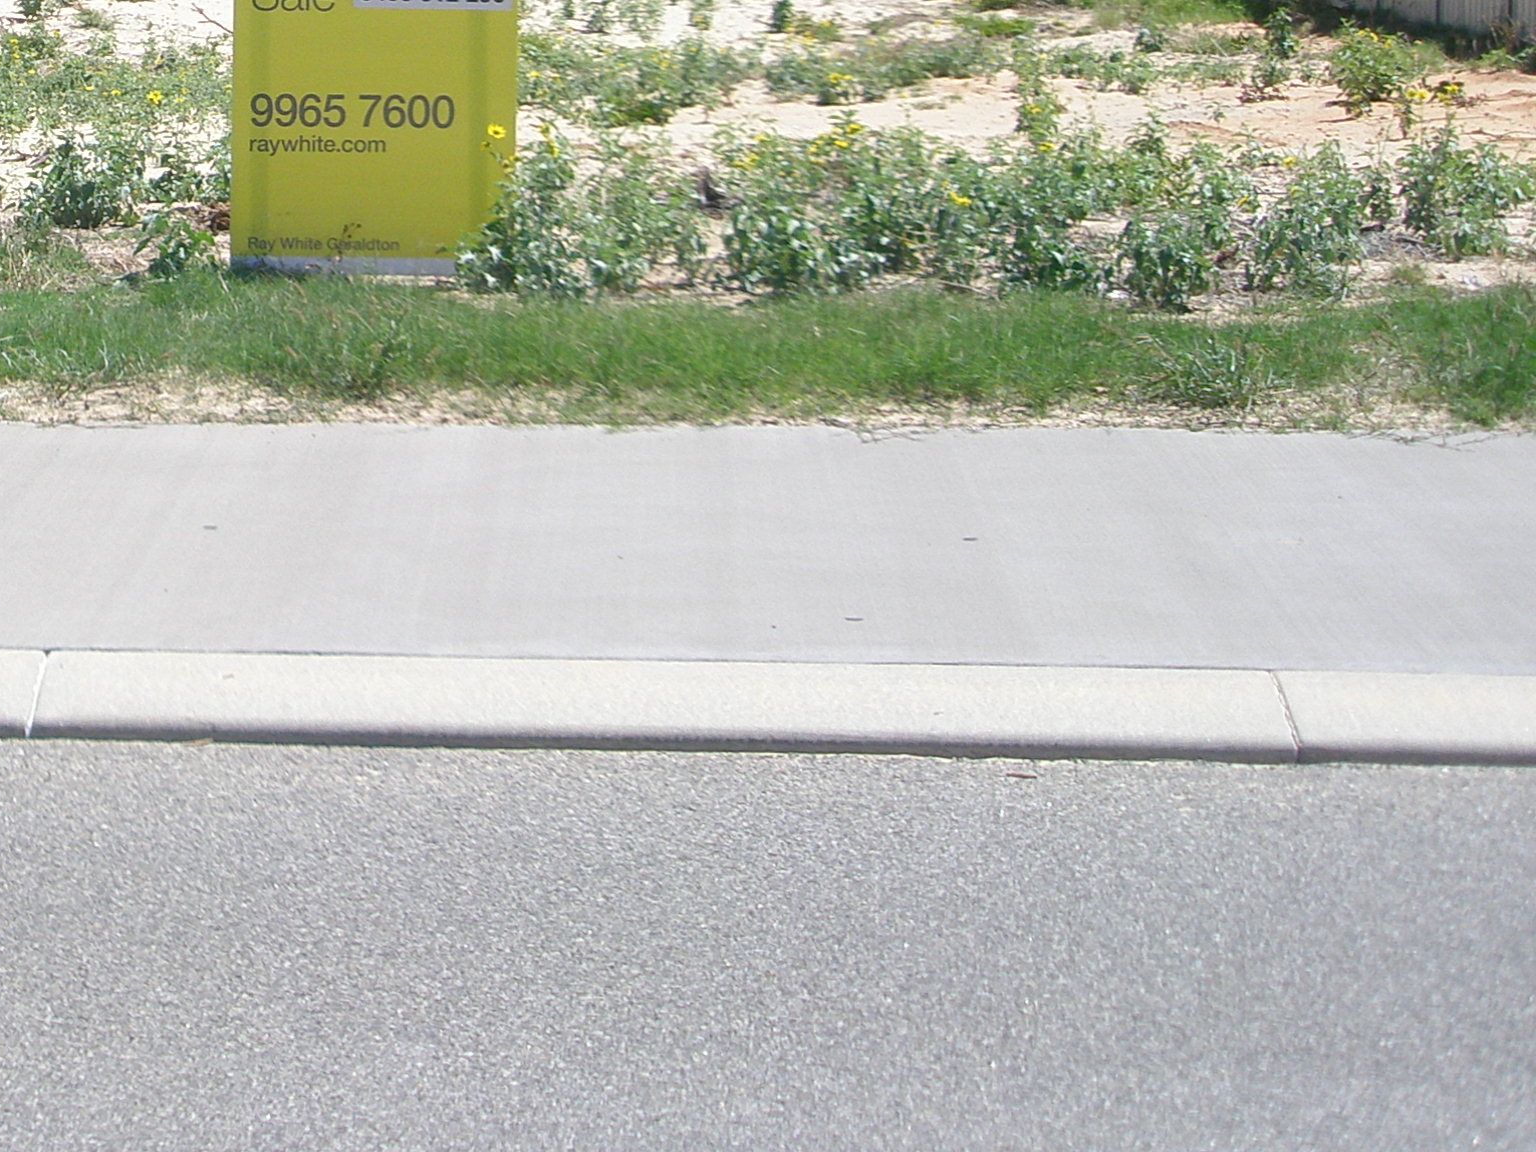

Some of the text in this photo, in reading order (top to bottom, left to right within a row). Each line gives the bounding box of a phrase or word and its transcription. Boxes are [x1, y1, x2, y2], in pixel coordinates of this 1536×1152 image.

[250, 93, 455, 129] 9965 7600
[249, 134, 386, 157] raywhite.com
[247, 236, 276, 251] Ray
[279, 236, 323, 250] White
